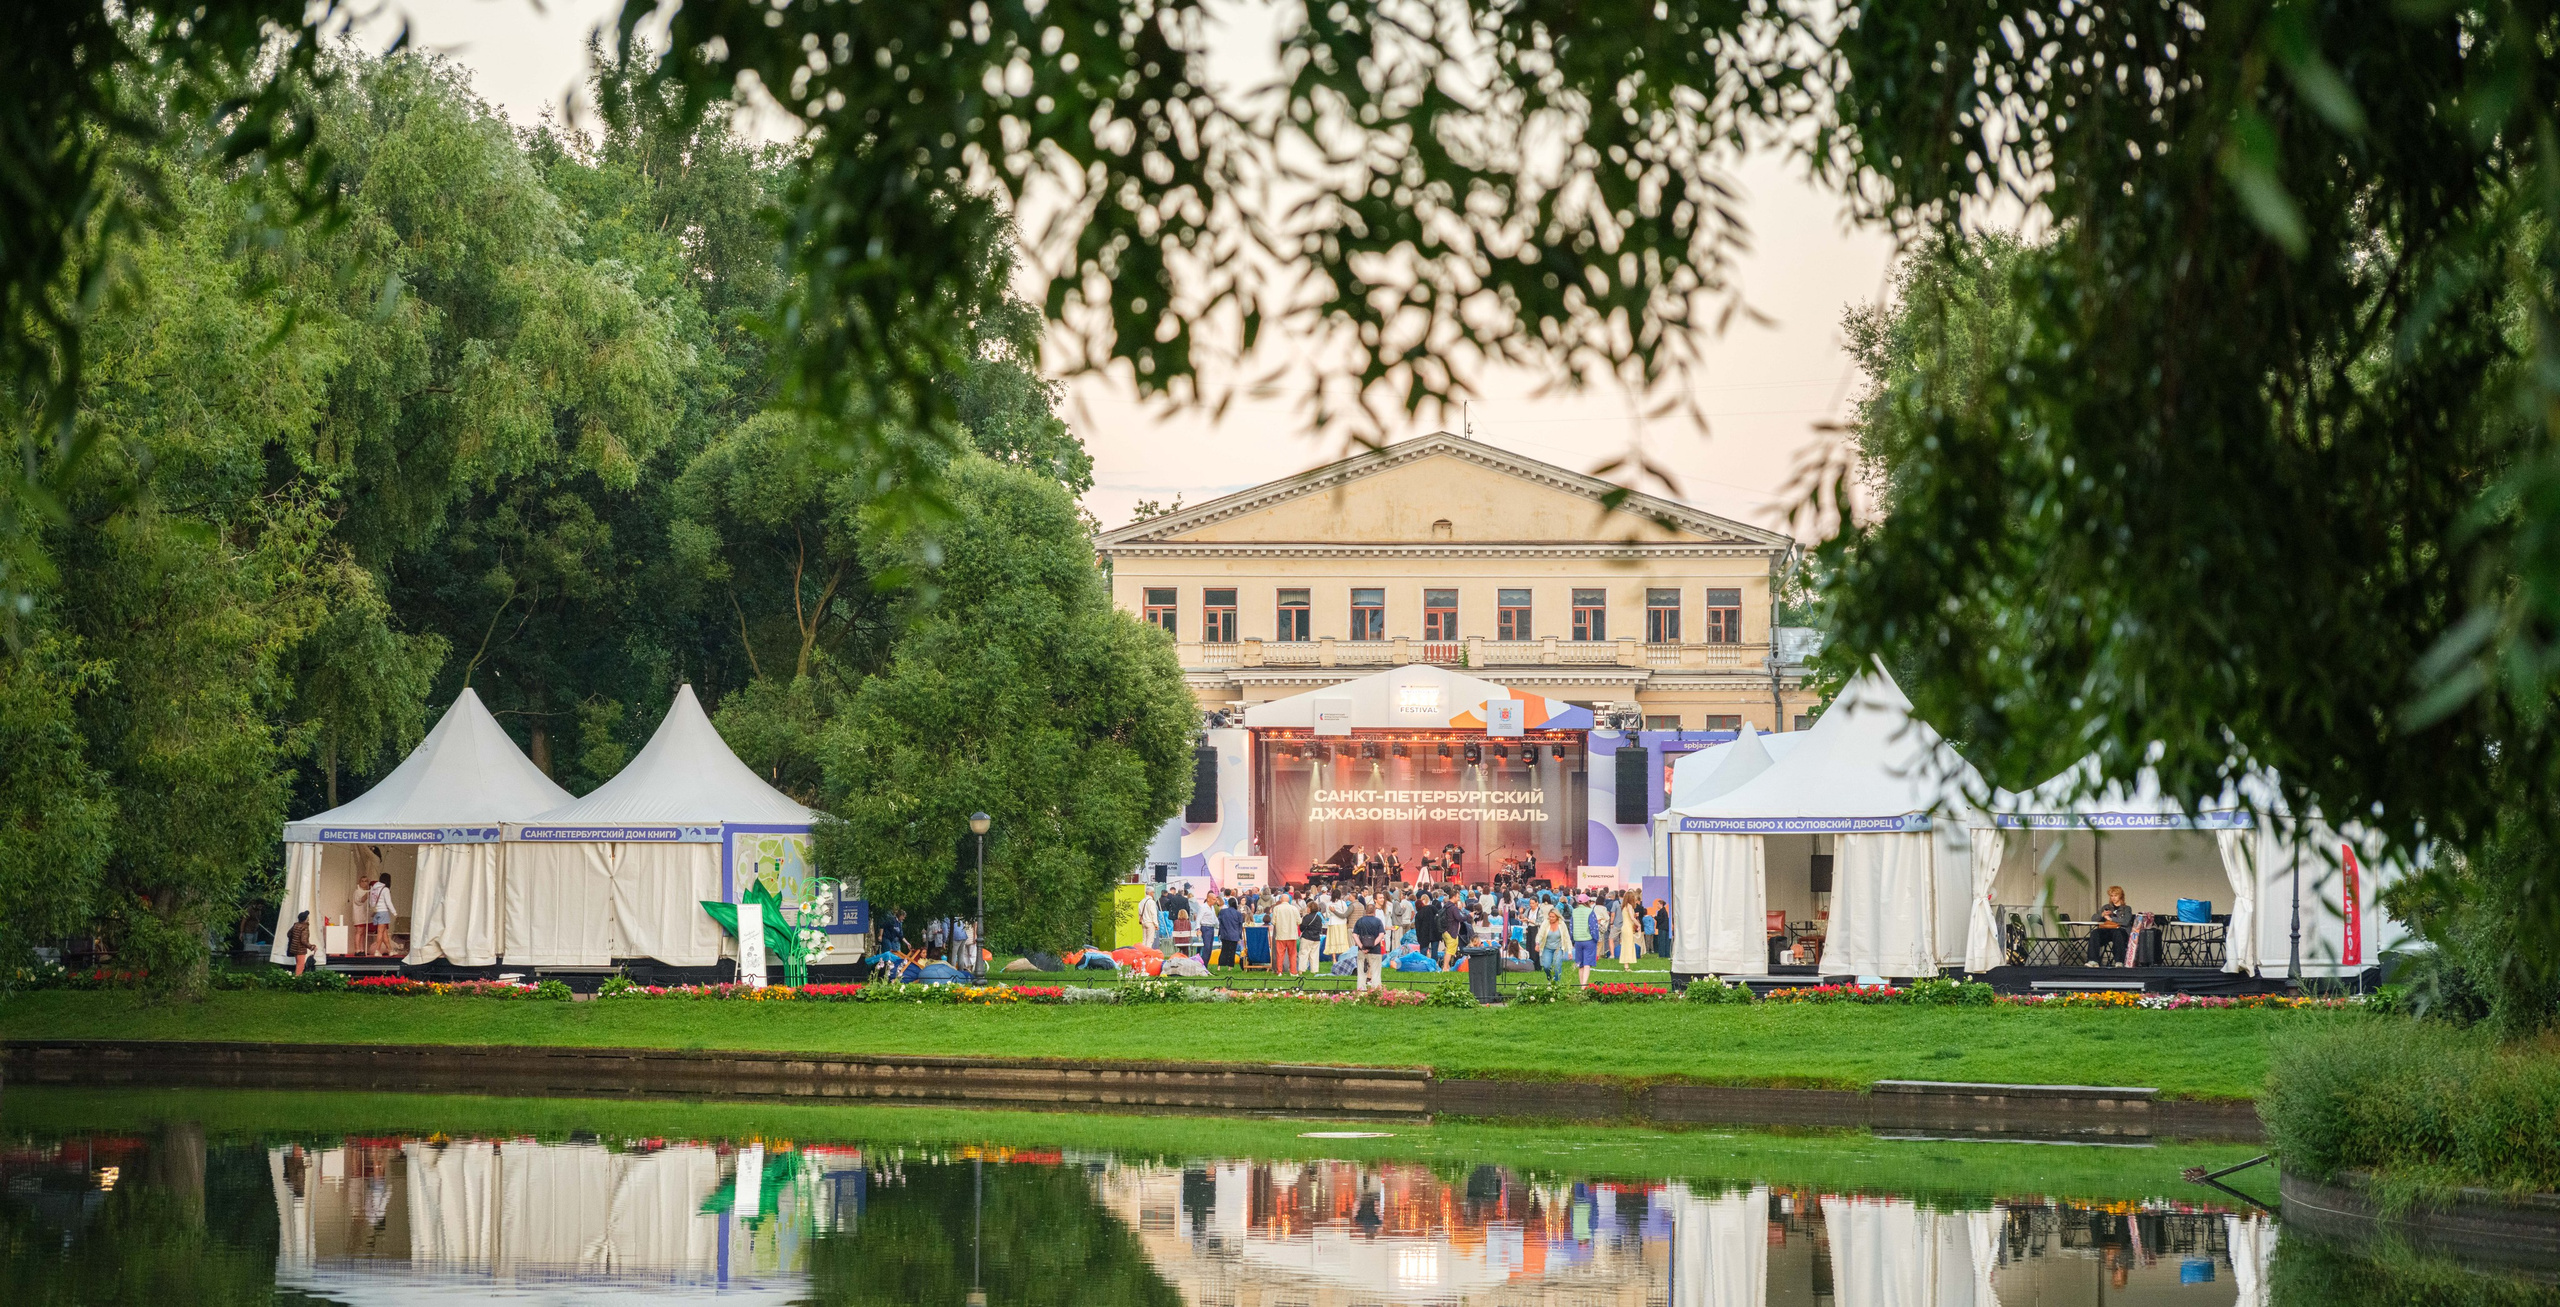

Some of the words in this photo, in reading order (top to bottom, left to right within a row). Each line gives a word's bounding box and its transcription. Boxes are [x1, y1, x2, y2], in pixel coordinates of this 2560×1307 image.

[1313, 788, 1544, 804] САНКТ-ПЕТЕРБУРГСКИЙ
[1308, 805, 1427, 822] ДЖАЗОВЫЙ
[1429, 808, 1549, 822] ФЕСТИВАЛЬ
[1686, 819, 1745, 829] КУЛЬТУРНОЕ
[1747, 820, 1776, 830] БЮРО
[1785, 817, 1851, 829] ЮСУПОВСКИЙ
[1852, 818, 1893, 830] ДВОРЕЦ
[2089, 815, 2123, 826] GAGA
[2128, 816, 2170, 826] GAMES
[324, 831, 358, 840] ВМЕСТЕ
[360, 832, 376, 840] МЫ
[378, 831, 436, 841] СПРАВИМСЯ!
[525, 828, 624, 839] САНКТ-ПЕТЕРБУРГСКИЙ
[626, 830, 646, 840] ДОМ
[648, 830, 676, 839] КНИГИ
[843, 912, 858, 920] JAZZ
